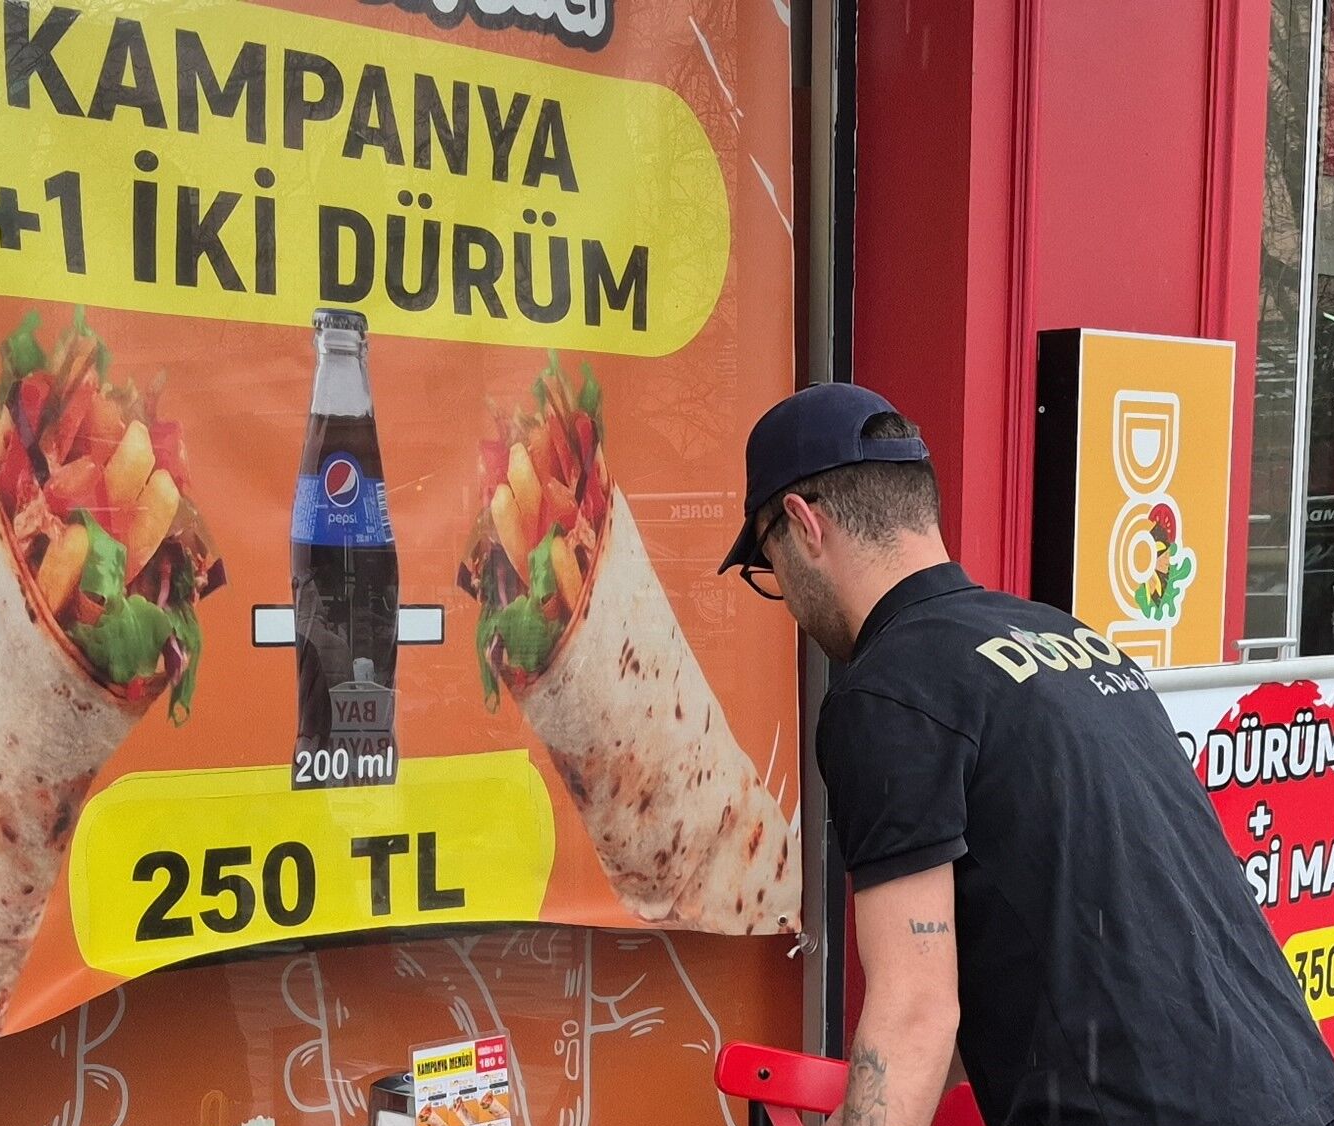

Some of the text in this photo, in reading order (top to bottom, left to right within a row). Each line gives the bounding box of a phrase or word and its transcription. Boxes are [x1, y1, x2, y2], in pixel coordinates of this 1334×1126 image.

[3, 2, 579, 193] KAMPANYA
[132, 150, 278, 295] İKİ
[317, 191, 650, 332] DÜRÜM
[328, 511, 358, 526] pepsi
[296, 748, 349, 782] 200
[357, 745, 393, 778] ml
[132, 832, 465, 942] 250 TL
[417, 1059, 447, 1076] KAMPANYA
